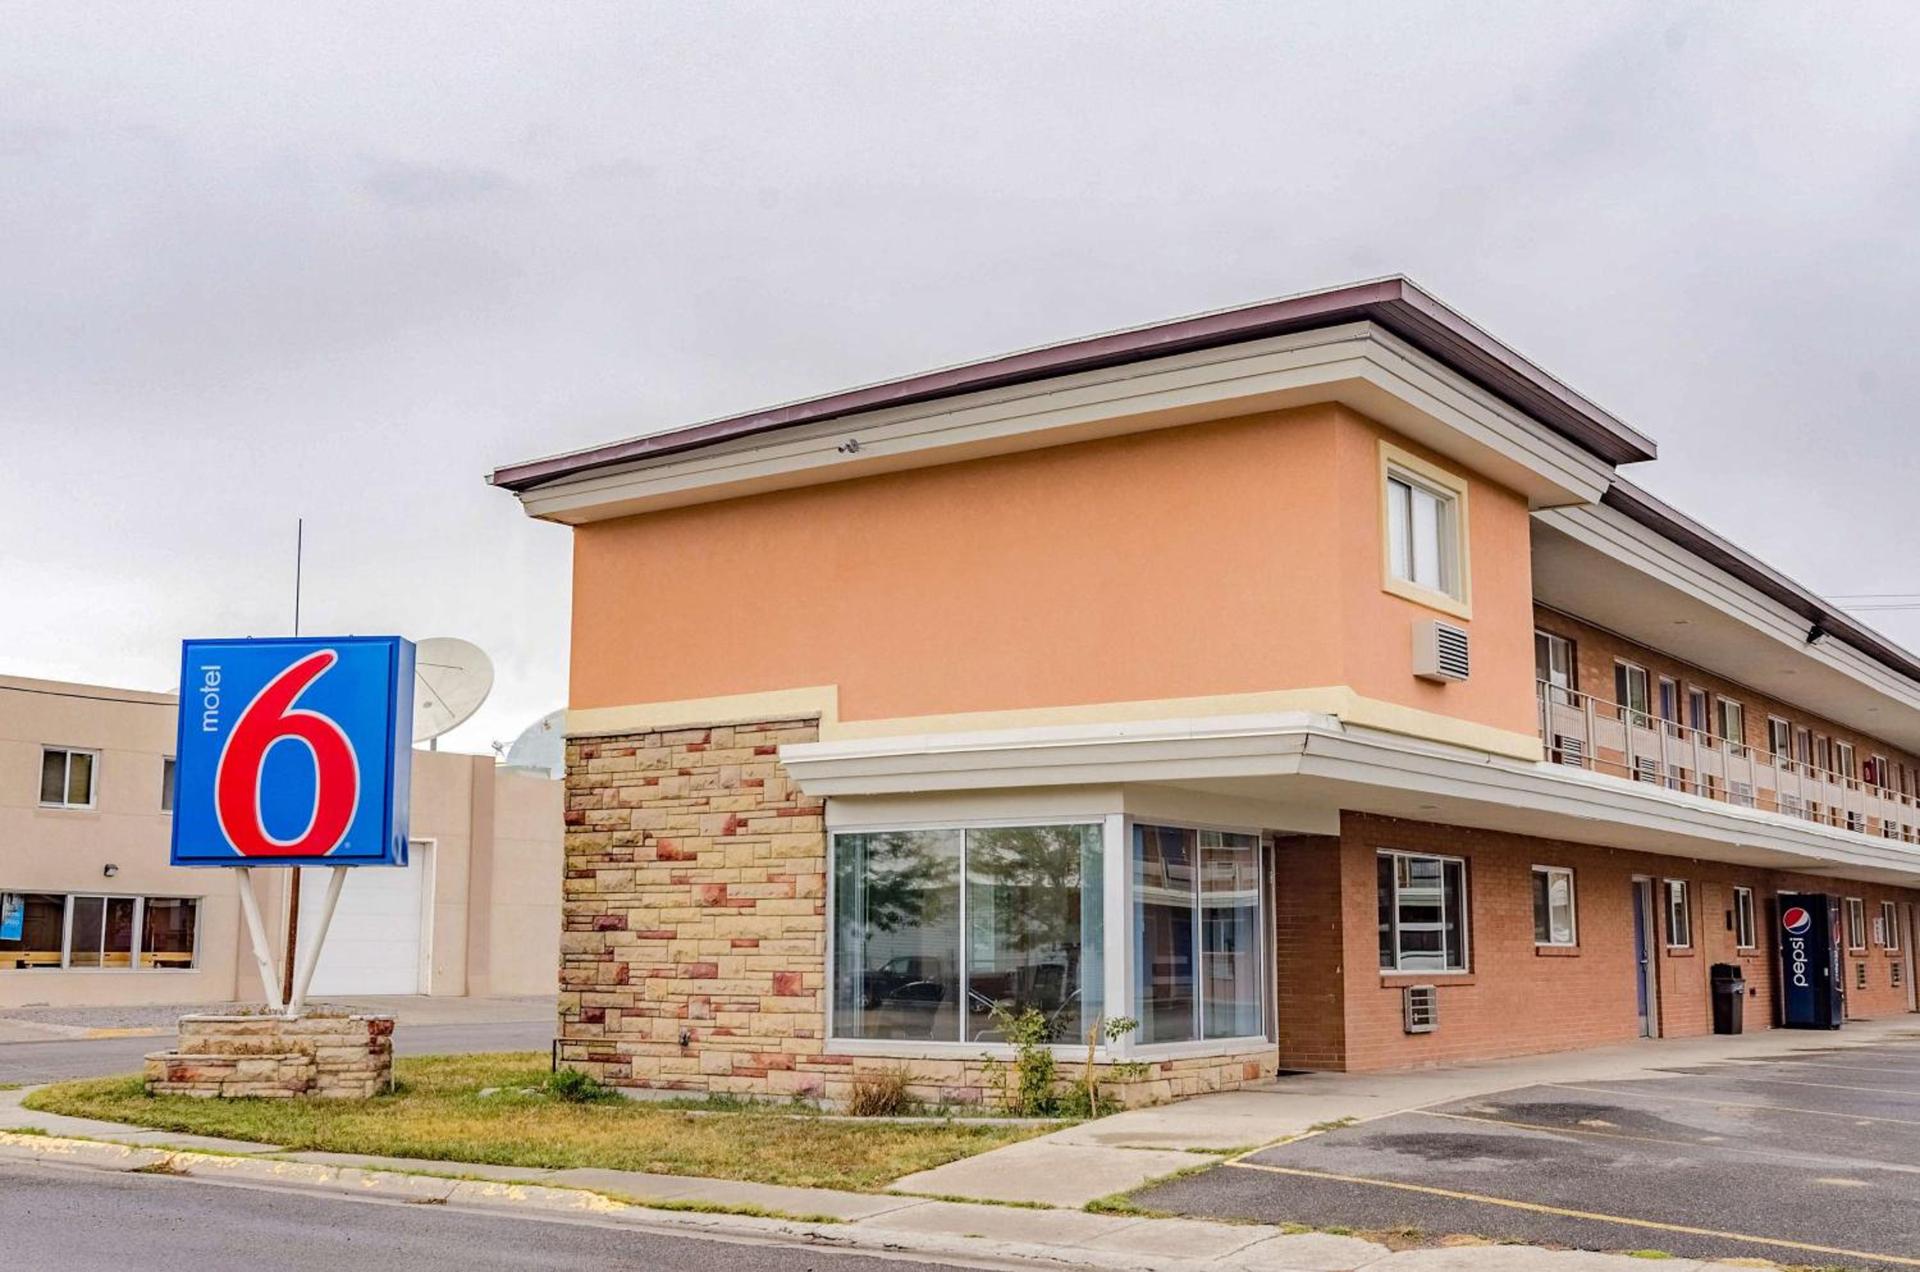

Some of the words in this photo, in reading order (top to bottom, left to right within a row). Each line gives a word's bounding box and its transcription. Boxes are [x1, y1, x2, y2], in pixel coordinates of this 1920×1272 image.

[200, 665, 221, 732] motel
[214, 648, 360, 857] 6
[1789, 937, 1808, 987] pepsi
